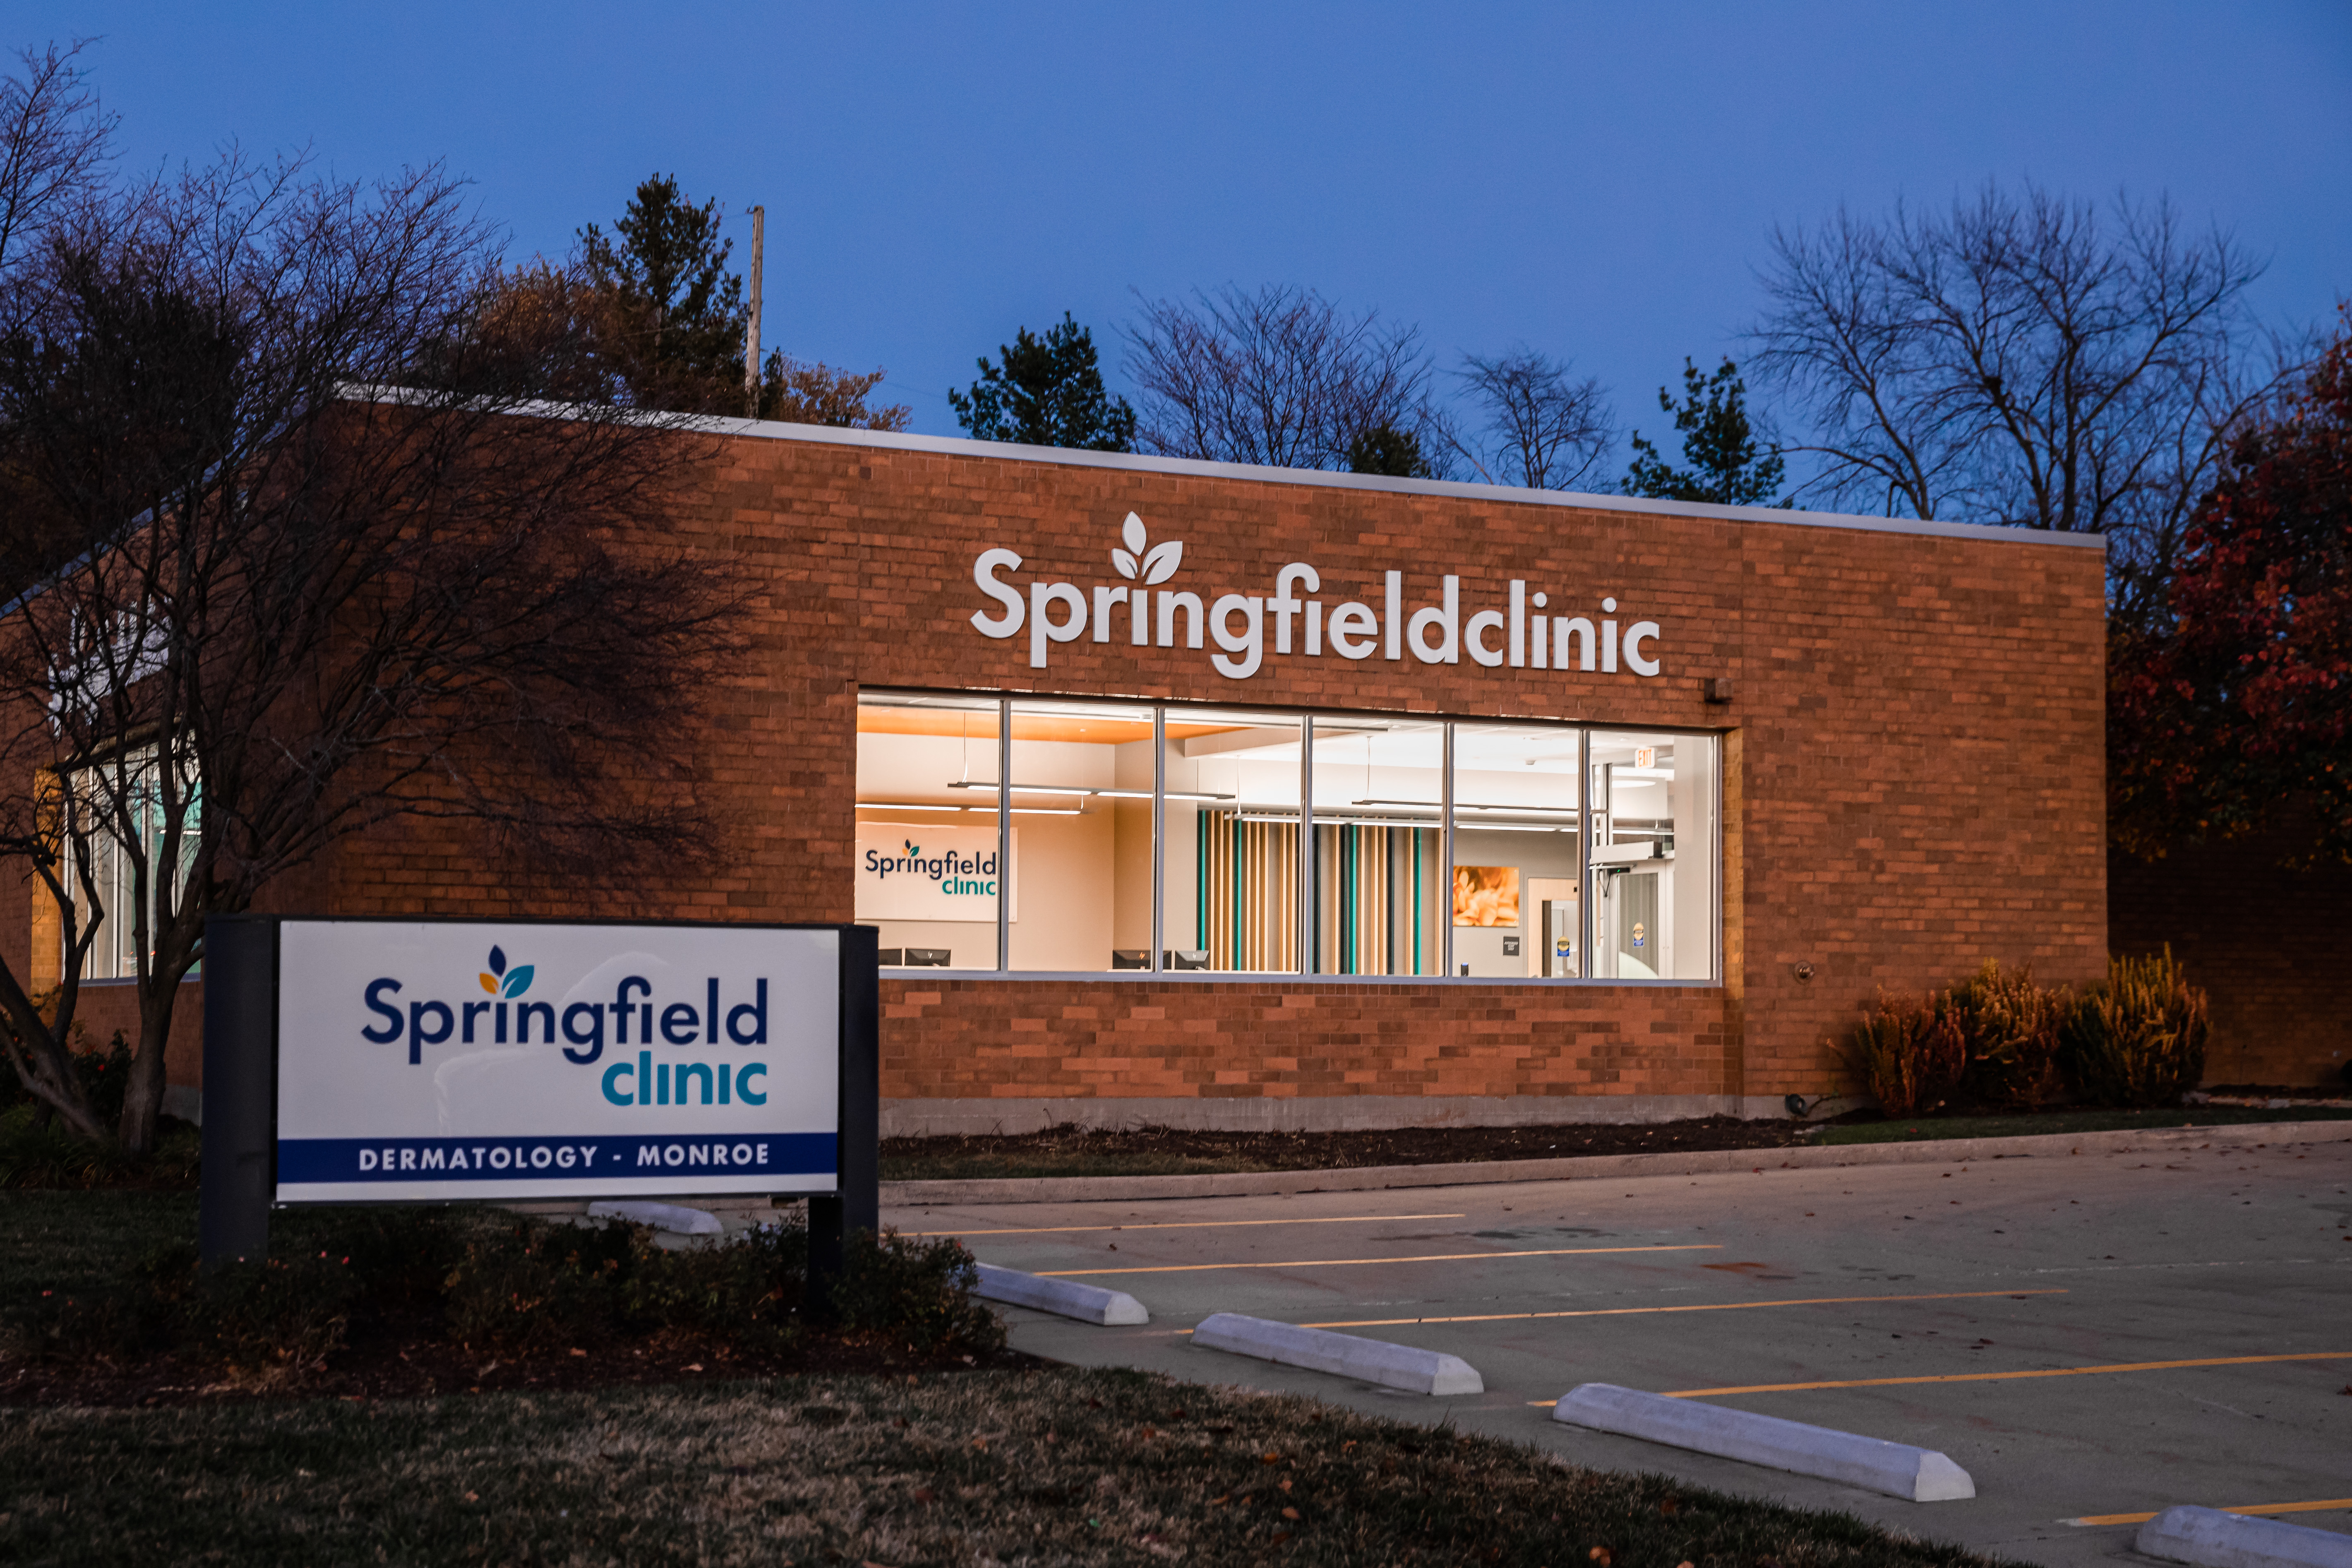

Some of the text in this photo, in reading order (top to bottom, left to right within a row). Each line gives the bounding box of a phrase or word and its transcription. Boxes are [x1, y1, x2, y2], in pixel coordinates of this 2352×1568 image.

[1639, 749, 1651, 767] EXIT
[865, 850, 996, 880] Springfield
[942, 876, 996, 895] clinic
[361, 976, 767, 1065] Springfield
[602, 1051, 767, 1106] clinic
[359, 1145, 597, 1170] DERMATOLOGY
[637, 1143, 768, 1166] MONROE
